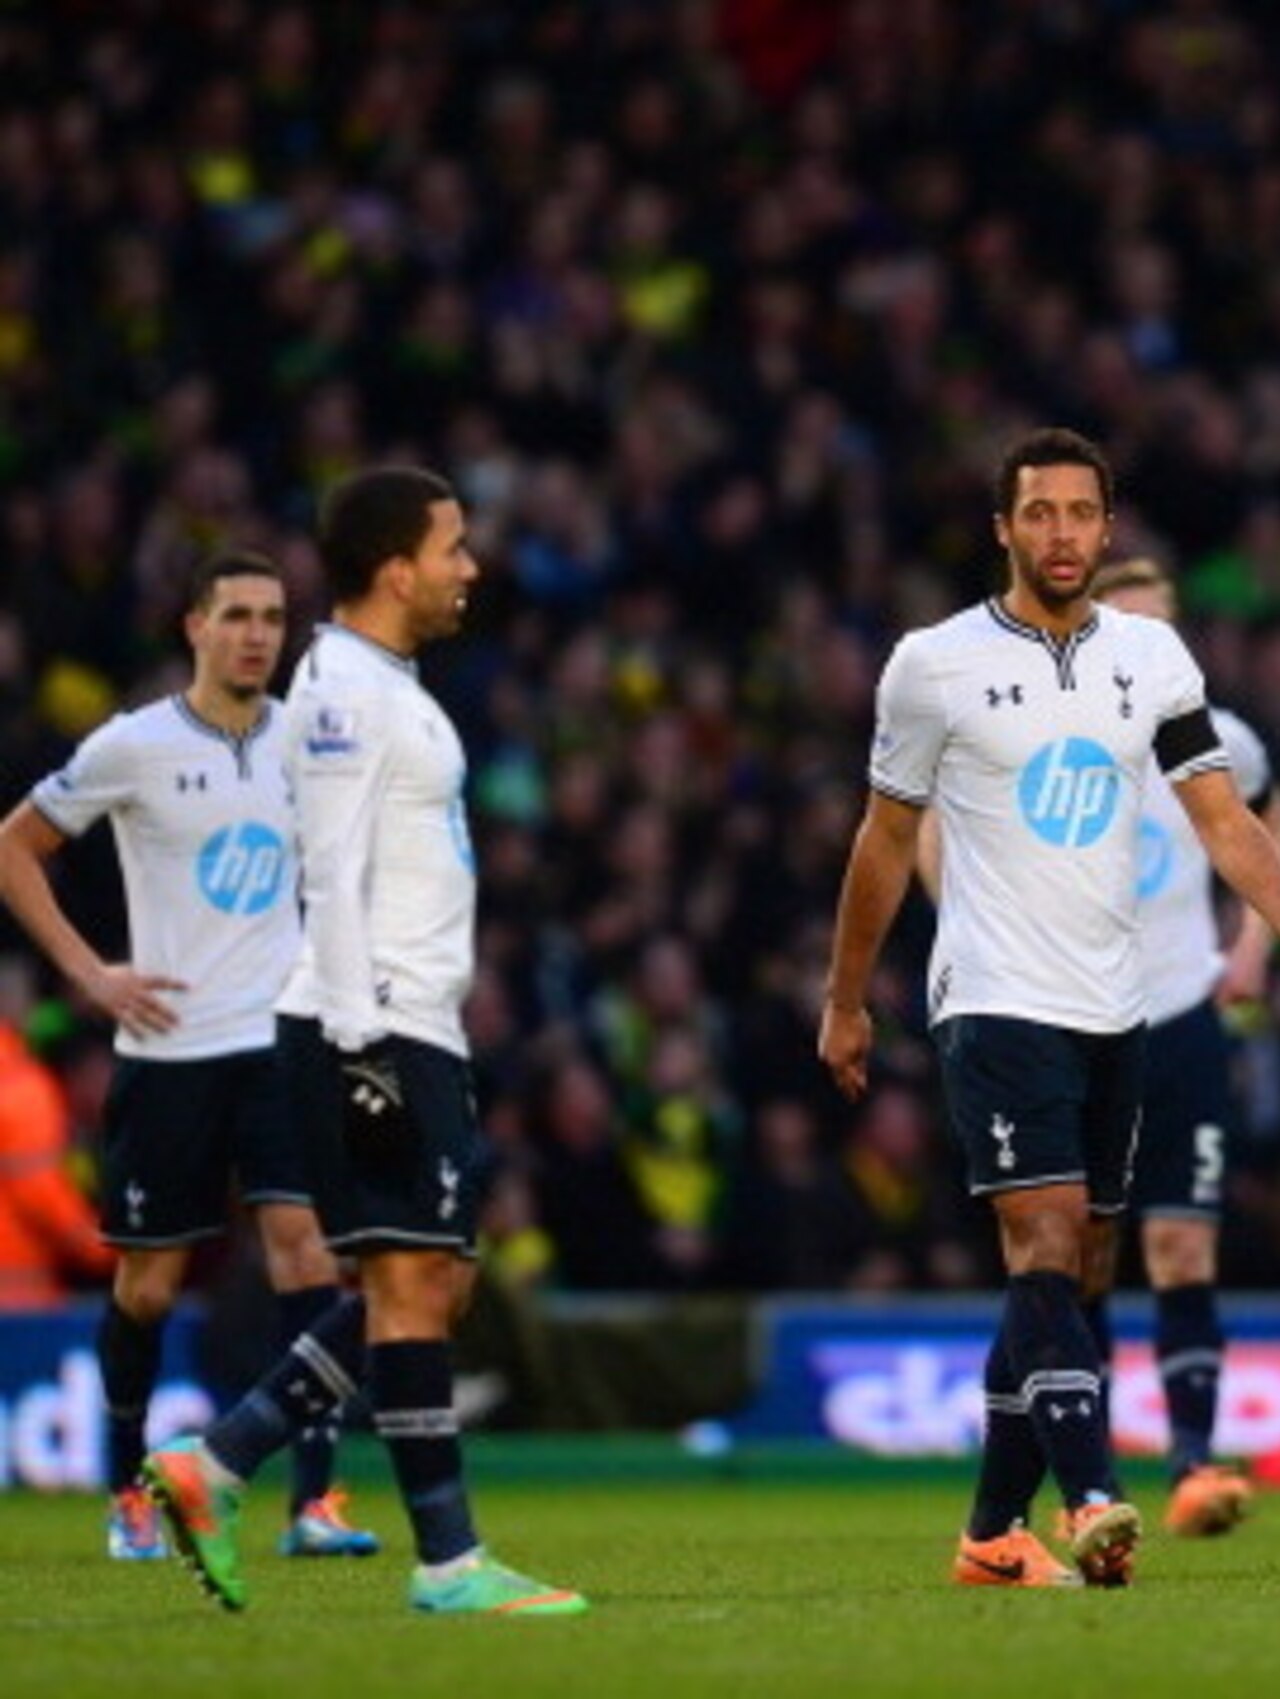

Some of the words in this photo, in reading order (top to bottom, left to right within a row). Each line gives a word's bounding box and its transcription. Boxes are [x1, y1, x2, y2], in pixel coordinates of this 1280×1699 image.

[1034, 736, 1114, 846] hp
[207, 821, 281, 914] hp
[1193, 1122, 1225, 1182] 5
